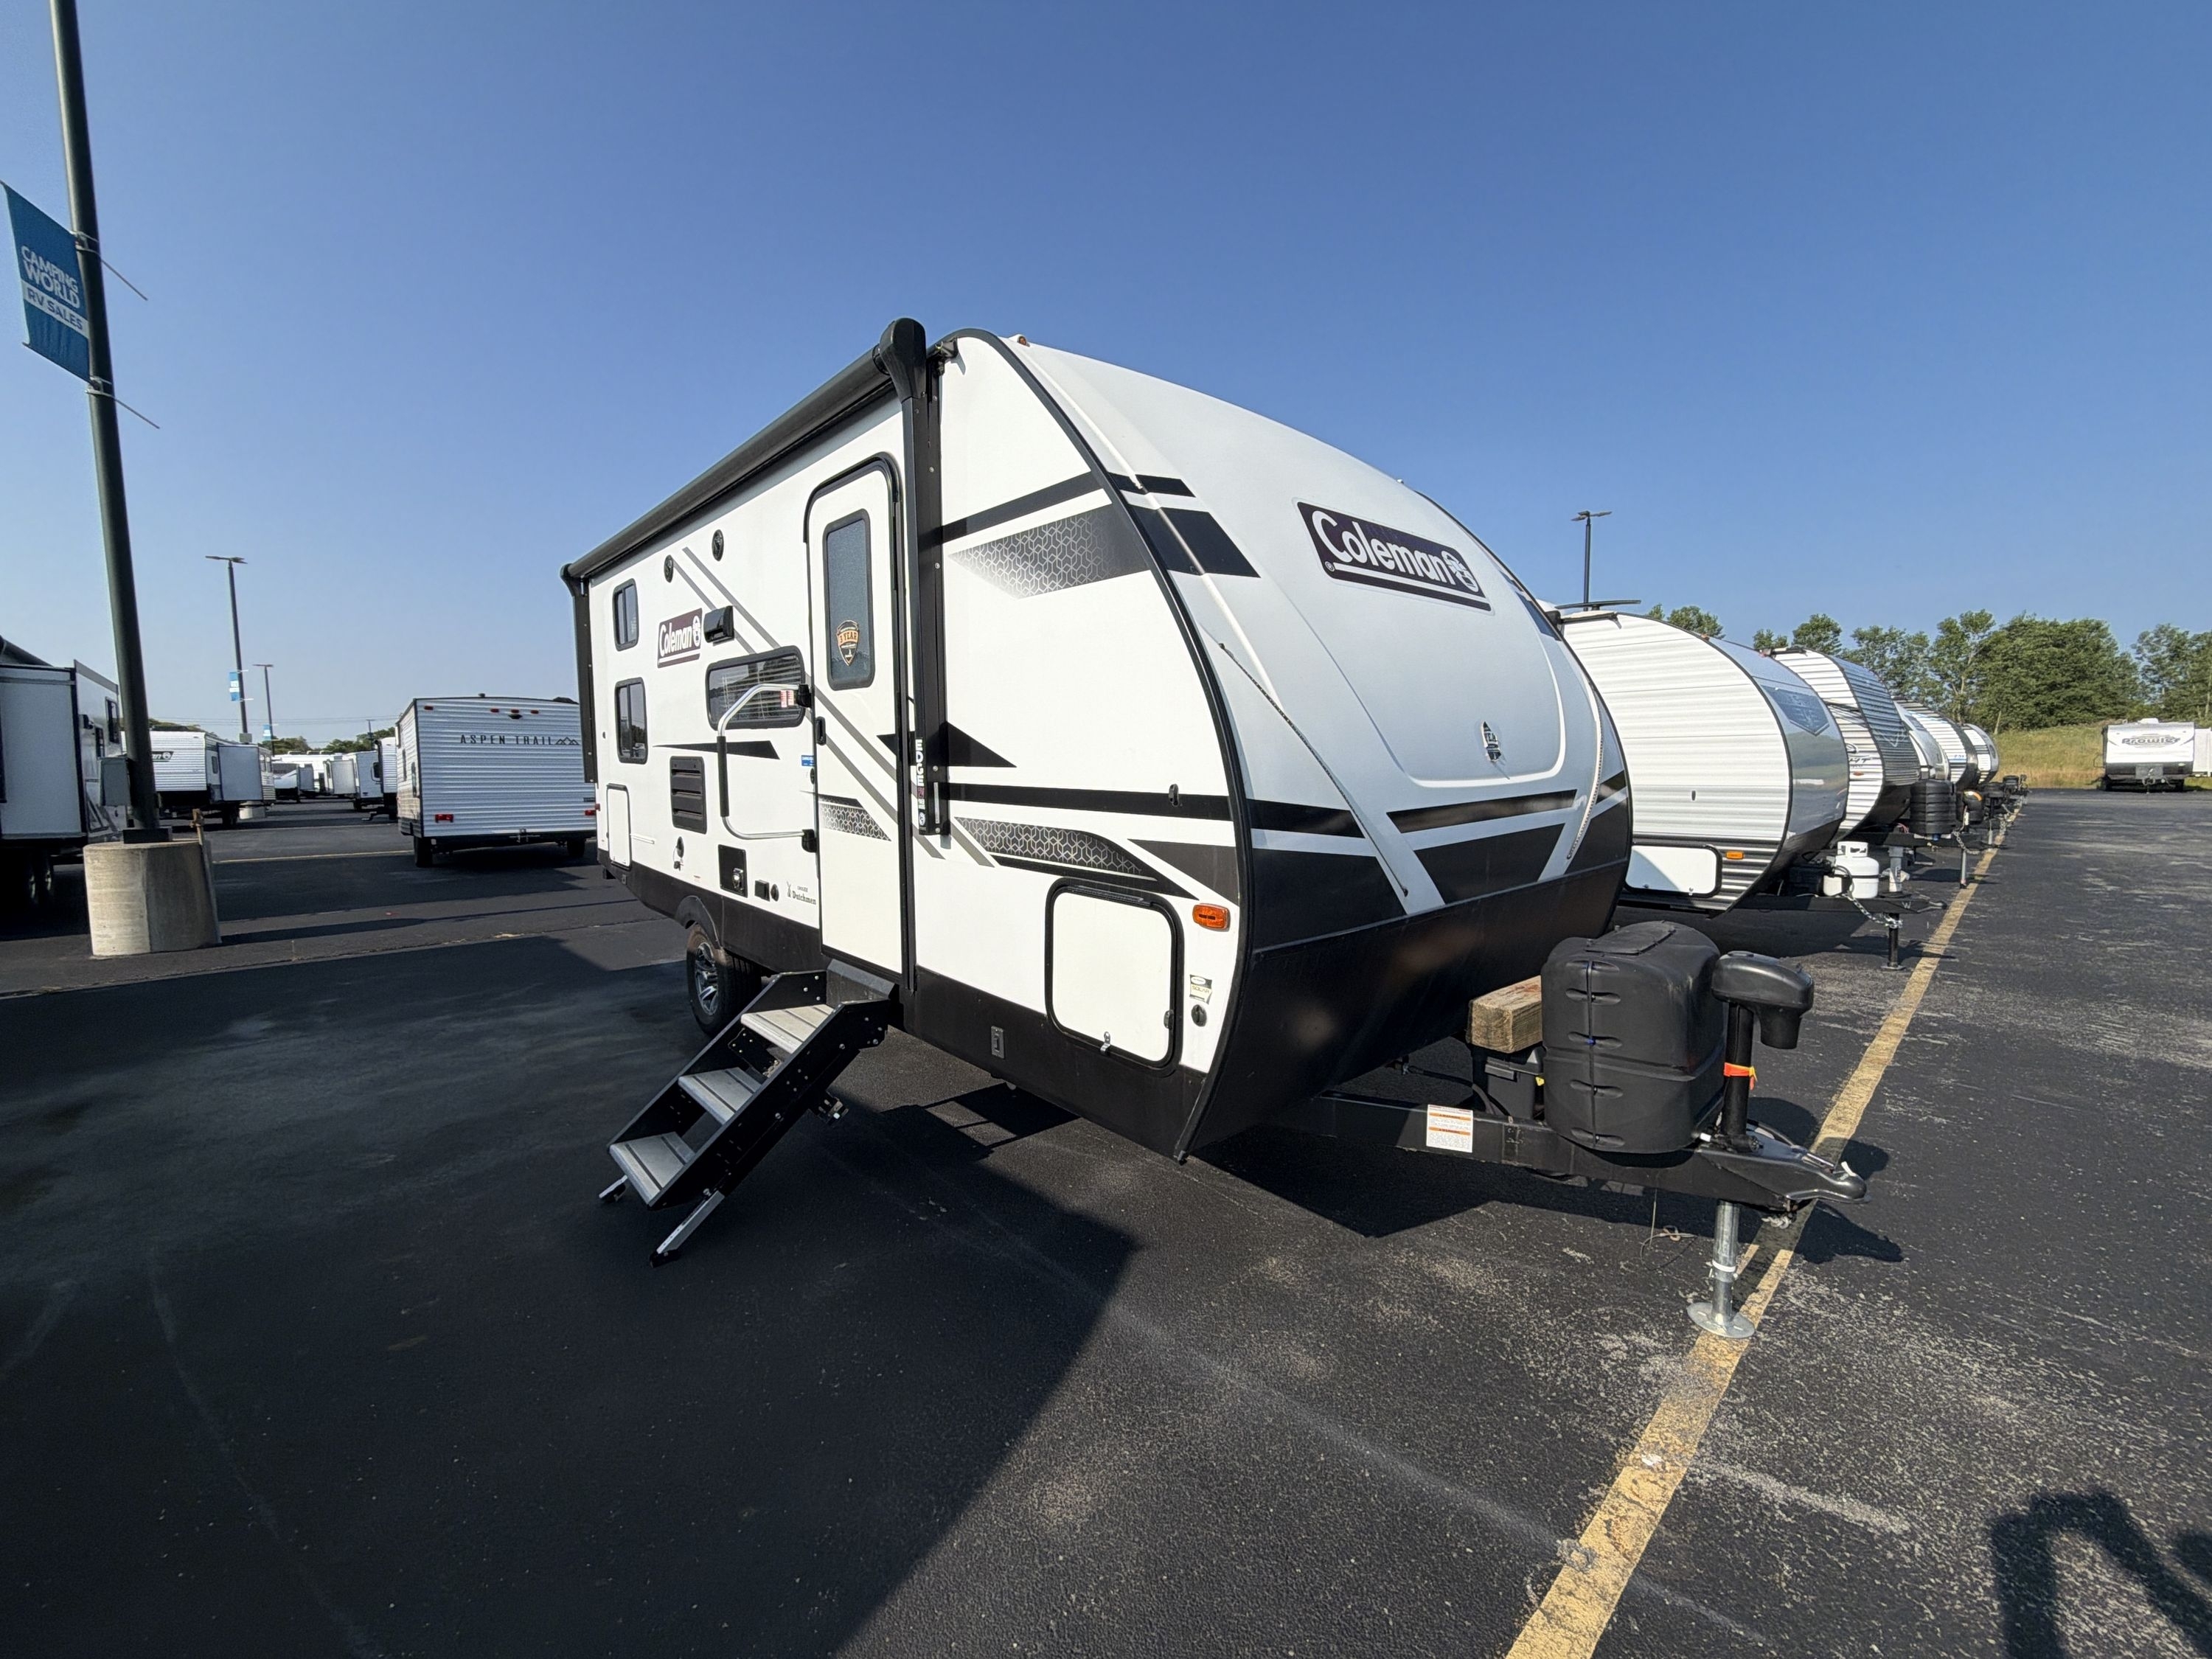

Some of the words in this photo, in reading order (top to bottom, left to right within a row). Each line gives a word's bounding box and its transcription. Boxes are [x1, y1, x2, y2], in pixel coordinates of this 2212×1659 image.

[21, 246, 79, 293] CAMPING
[23, 260, 80, 308] WORLD
[27, 286, 45, 307] RV
[47, 301, 83, 330] SALES
[1312, 510, 1456, 585] Coleman
[659, 622, 692, 658] Coleman
[844, 631, 857, 641] YEAR
[460, 734, 506, 745] ASPEN
[515, 734, 554, 745] TRAIL
[792, 890, 816, 905] Dutchmen
[1192, 985, 1210, 994] SOLAR
